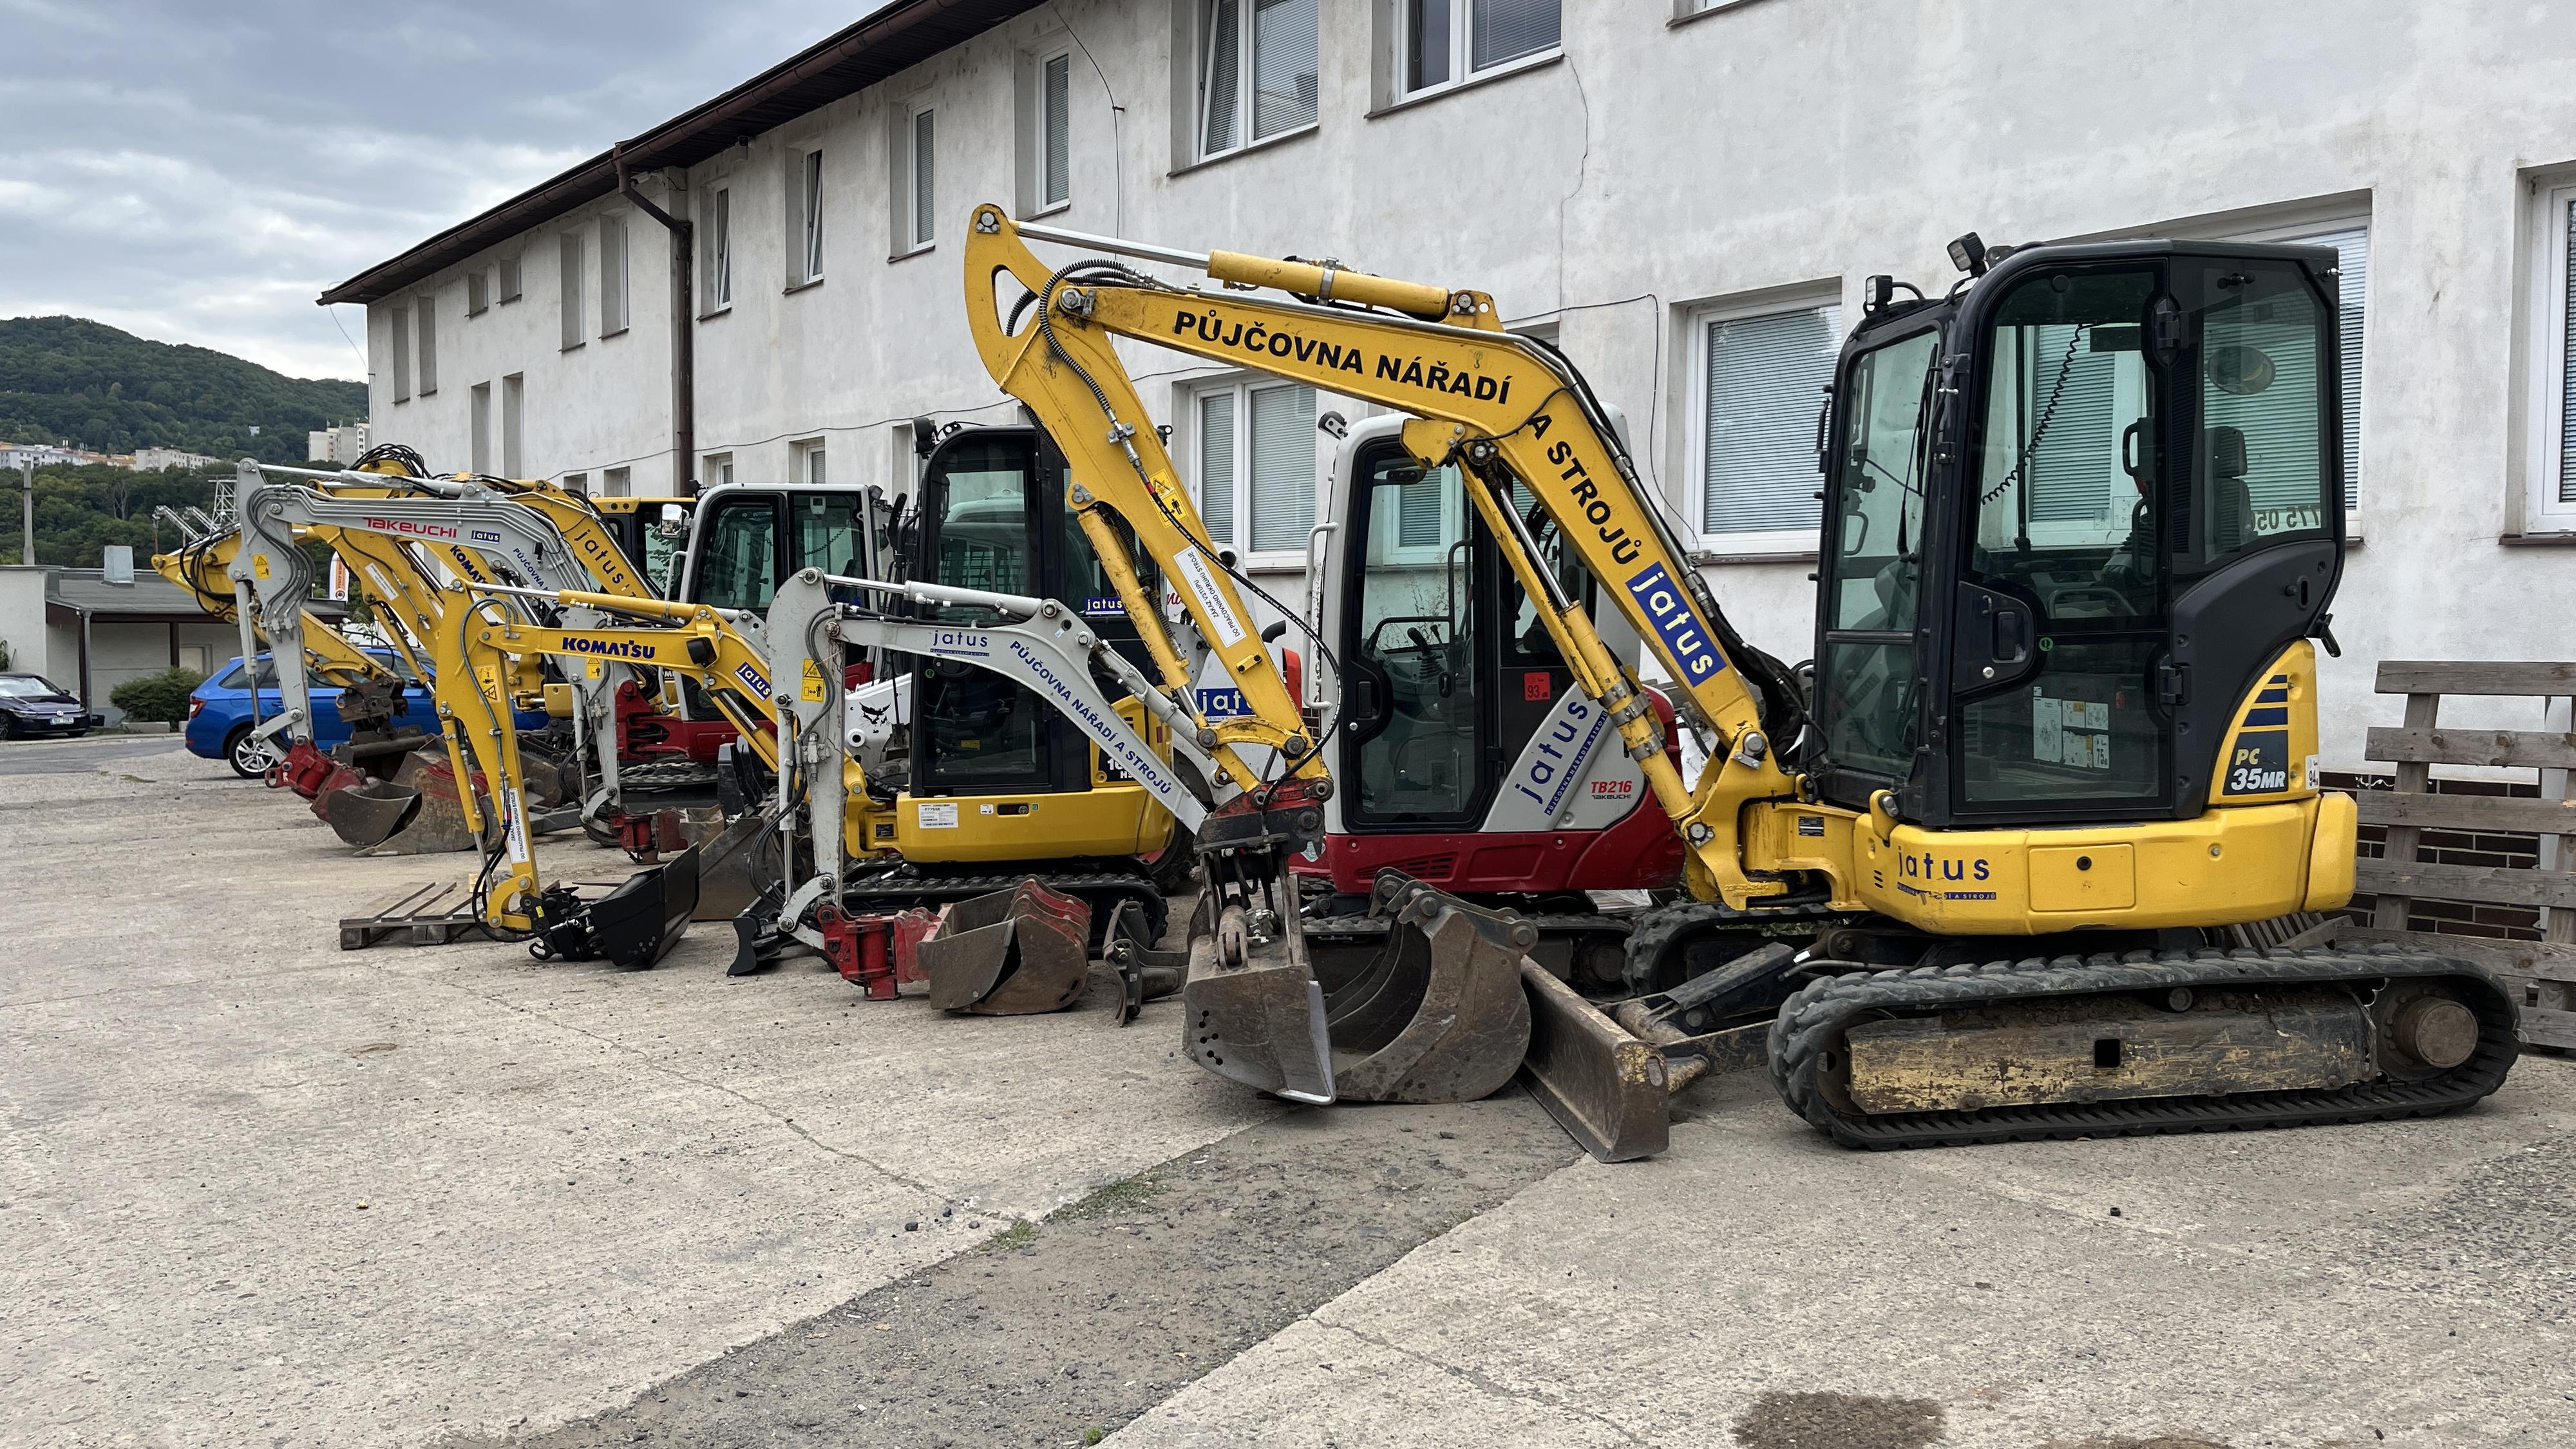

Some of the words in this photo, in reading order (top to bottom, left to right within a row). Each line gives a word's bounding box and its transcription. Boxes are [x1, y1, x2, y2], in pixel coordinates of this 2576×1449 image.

[1173, 310, 1364, 375] PŮJČOVNA
[1376, 355, 1512, 404] NÁŘADÍ
[1527, 414, 1552, 440] A
[1547, 440, 1642, 565] STROJŮ
[473, 531, 499, 541] jatus
[574, 529, 624, 584] jatus
[1188, 551, 1203, 573] STROJE
[1193, 580, 1209, 601] VSTUPU
[1202, 573, 1215, 594] OKRUHU
[1087, 599, 1122, 611] jatus
[1232, 629, 1240, 637] DO
[1631, 571, 1714, 675] jatus
[562, 637, 656, 659] KOMATSU
[933, 630, 988, 647] jatus
[738, 664, 771, 696] jatus
[1202, 690, 1253, 714] jat
[1528, 685, 1539, 698] 93
[1010, 641, 1072, 701] PŮJČOVNA
[1072, 699, 1119, 742] NÁŘADÍ
[1114, 741, 1125, 753] A
[1125, 750, 1172, 795] STROJŮ
[1515, 701, 1588, 804] jatus
[2235, 748, 2260, 766] PC
[1591, 781, 1633, 793] TB216
[2231, 768, 2286, 790] 35MR
[1898, 846, 1990, 881] jatus
